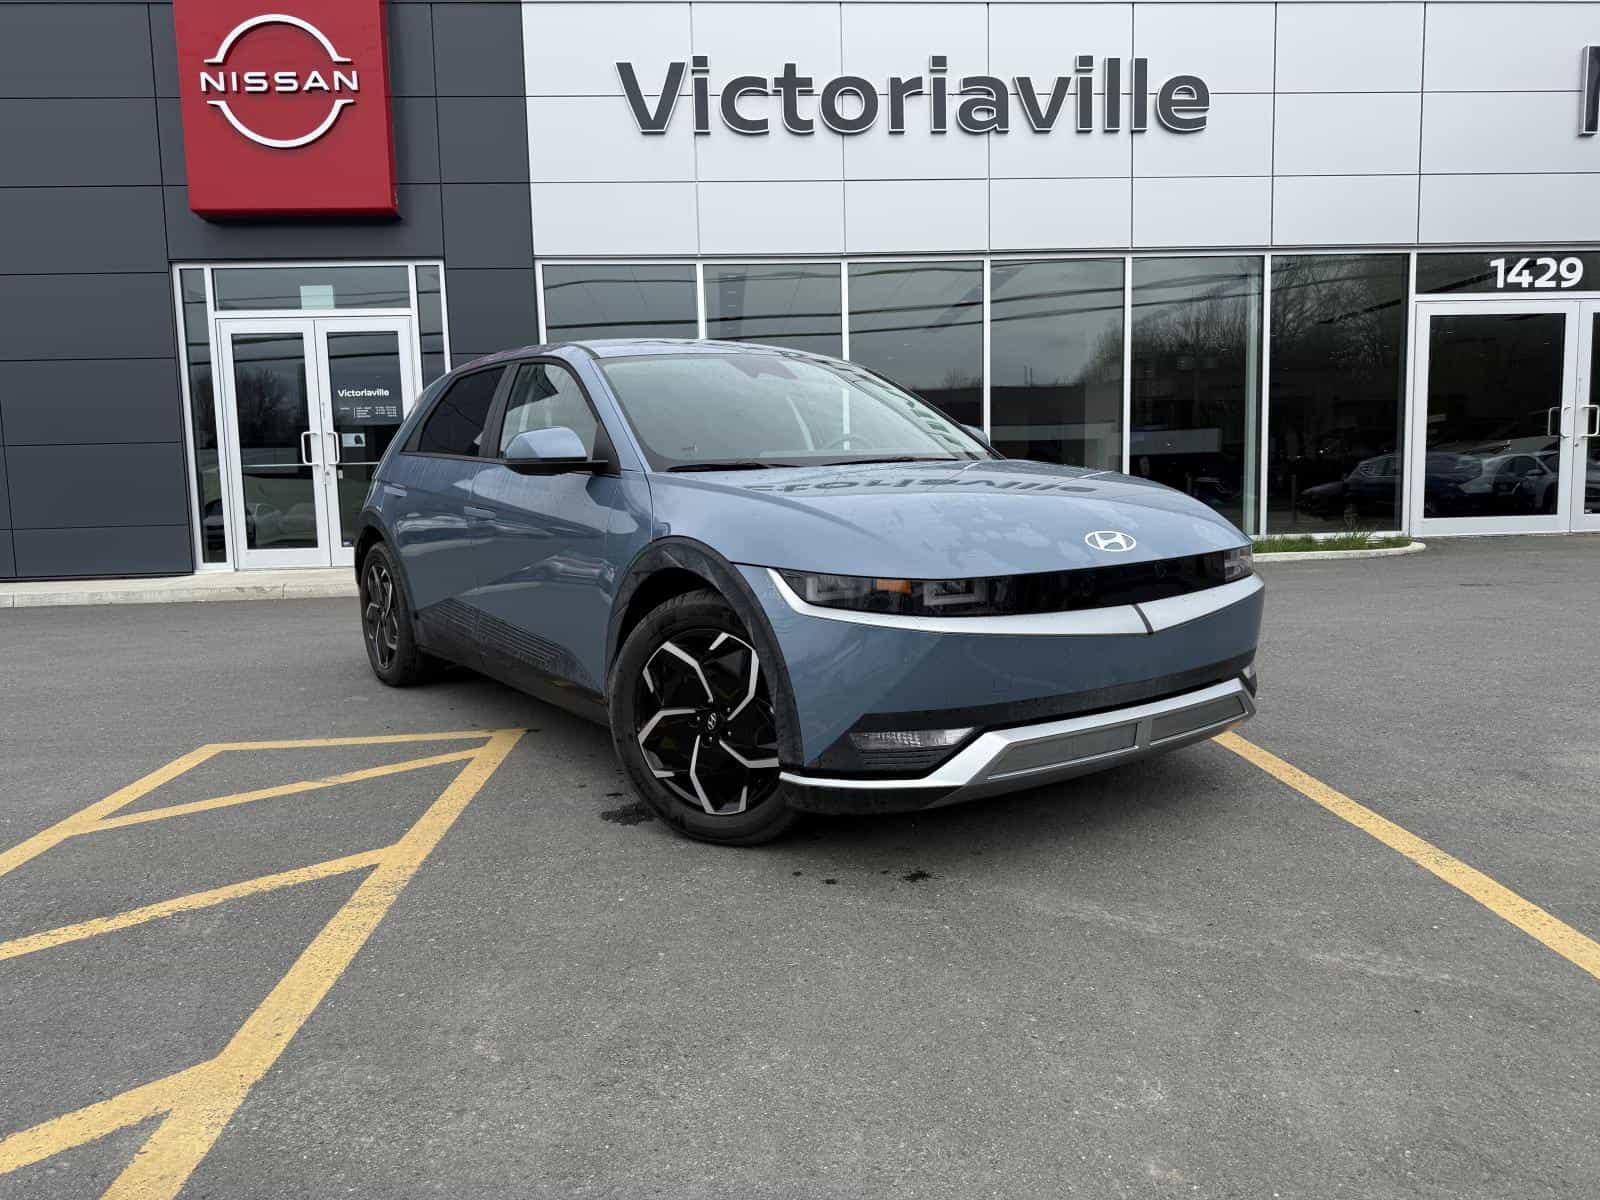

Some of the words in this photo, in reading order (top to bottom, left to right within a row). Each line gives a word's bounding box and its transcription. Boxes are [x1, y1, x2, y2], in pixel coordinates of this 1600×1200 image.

[199, 70, 359, 92] NISSAN
[614, 54, 1210, 136] Victoriaville
[1489, 256, 1584, 288] 1429
[338, 389, 390, 397] Victoriaville
